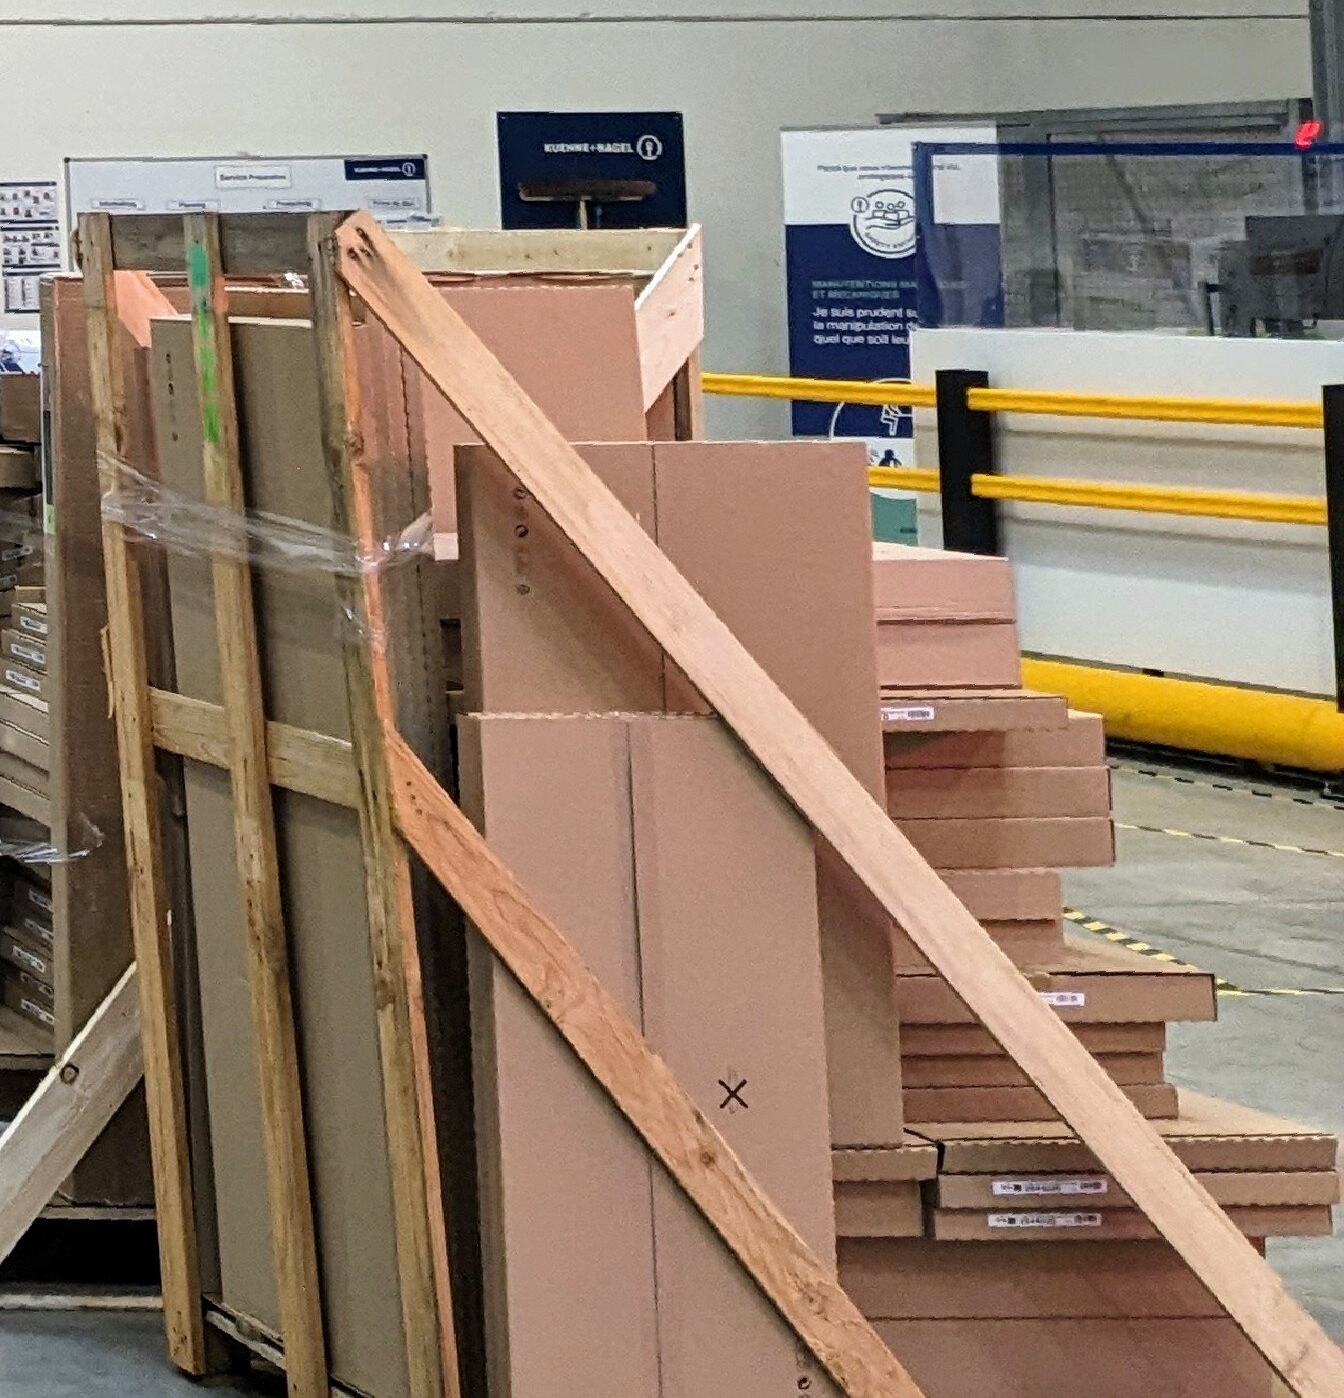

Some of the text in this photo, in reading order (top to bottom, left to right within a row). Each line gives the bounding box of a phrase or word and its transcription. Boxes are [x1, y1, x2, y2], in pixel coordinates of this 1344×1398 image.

[544, 143, 634, 153] KUEHNE+NAGEL
[813, 307, 828, 317] Je
[831, 307, 855, 317] suis
[856, 307, 903, 318] prudent
[814, 321, 825, 329] la
[826, 320, 903, 332] manipulation
[814, 334, 910, 345] quel que soit leu
